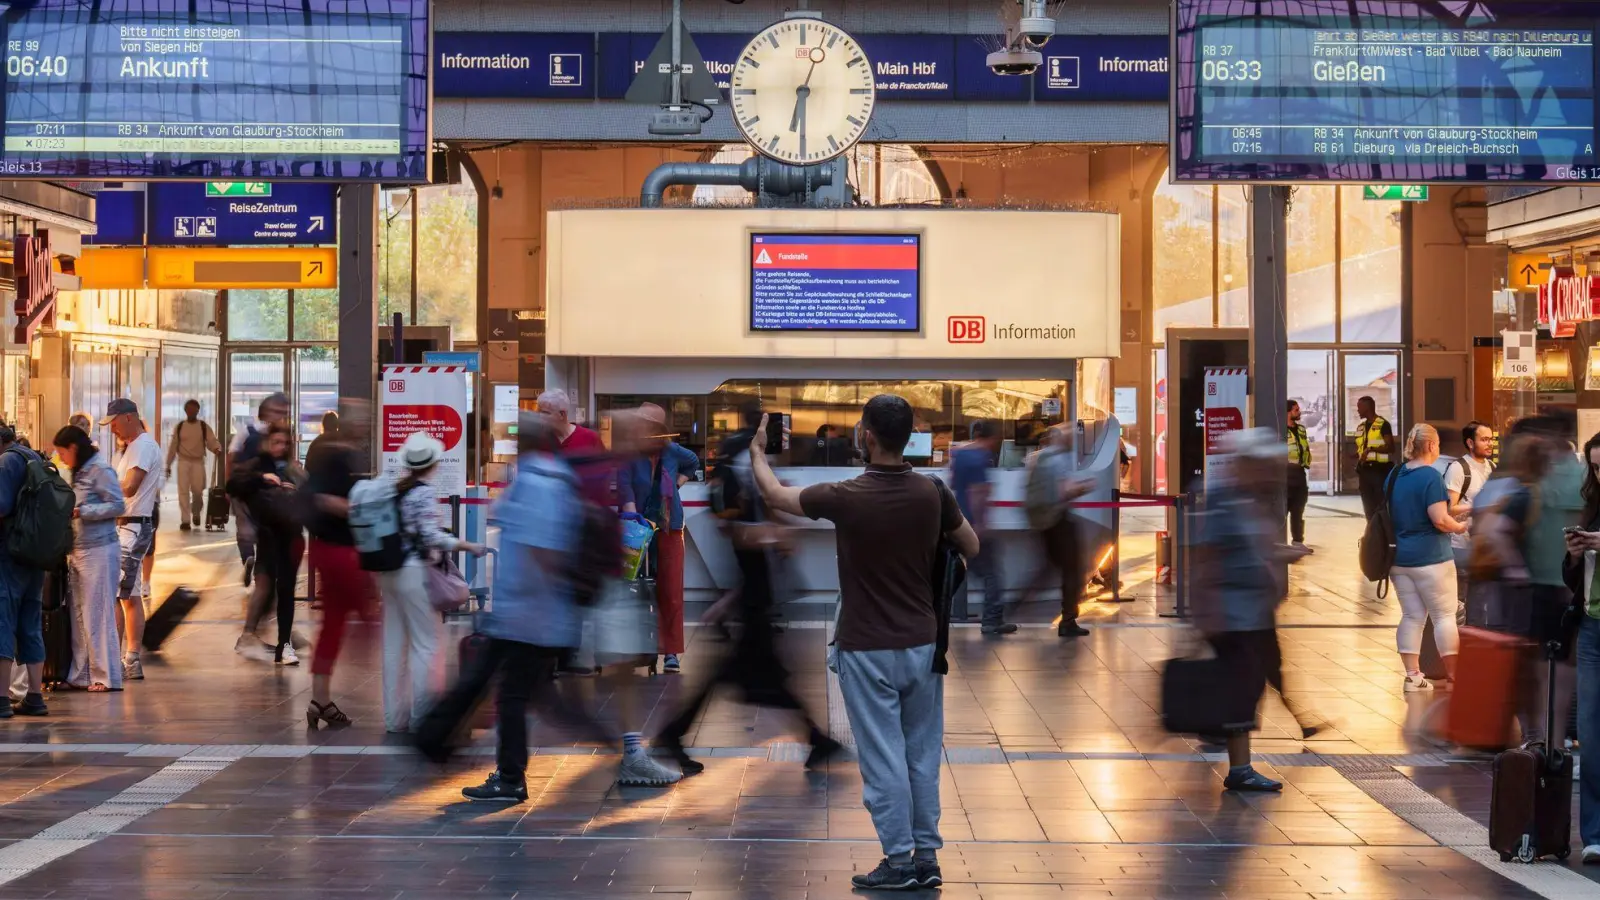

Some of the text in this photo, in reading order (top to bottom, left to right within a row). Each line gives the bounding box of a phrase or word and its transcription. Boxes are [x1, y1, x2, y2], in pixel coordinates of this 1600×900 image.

[120, 26, 240, 40] Bitte nicht einsteigen
[1362, 31, 1398, 42] Gießen
[1402, 32, 1438, 42] weiter
[1442, 32, 1459, 42] als
[1493, 32, 1521, 42] nach
[1523, 32, 1578, 43] Dillenburg
[8, 40, 39, 50] RE 99
[120, 42, 204, 54] von Siegen Hbf
[1202, 46, 1234, 56] RB 37
[1314, 46, 1562, 57] Frankfurt(M)West Bad Vilbel Bad Nauheim
[7, 56, 68, 76] 06:40
[120, 56, 209, 78] Ankunft
[442, 53, 530, 69] Information
[1100, 57, 1168, 72] Informati
[877, 62, 936, 75] Main Hbf
[1202, 60, 1262, 81] 06:33
[1313, 60, 1386, 82] Gießen
[899, 82, 948, 90] Francfort/Main
[36, 124, 65, 135] 07:11
[118, 125, 344, 138] RB 34 Ankunft von Glauburg-Stockheim
[1232, 128, 1262, 138] 06:45
[1314, 128, 1538, 141] RB 34 Ankunft von Glauburg-Stockheim
[36, 138, 65, 148] 07:23
[1232, 143, 1262, 153] 07:15
[1314, 143, 1327, 153] RB
[1331, 143, 1344, 153] 61
[1354, 143, 1395, 155] Dieburg
[1405, 143, 1421, 153] via
[1425, 143, 1519, 154] Dreieich-Buchsch
[29, 162, 42, 173] 13
[1556, 167, 1587, 178] Gleis
[230, 203, 297, 213] ReiseZentrum
[1556, 275, 1592, 322] CROBAG
[952, 320, 1076, 339] DB Information
